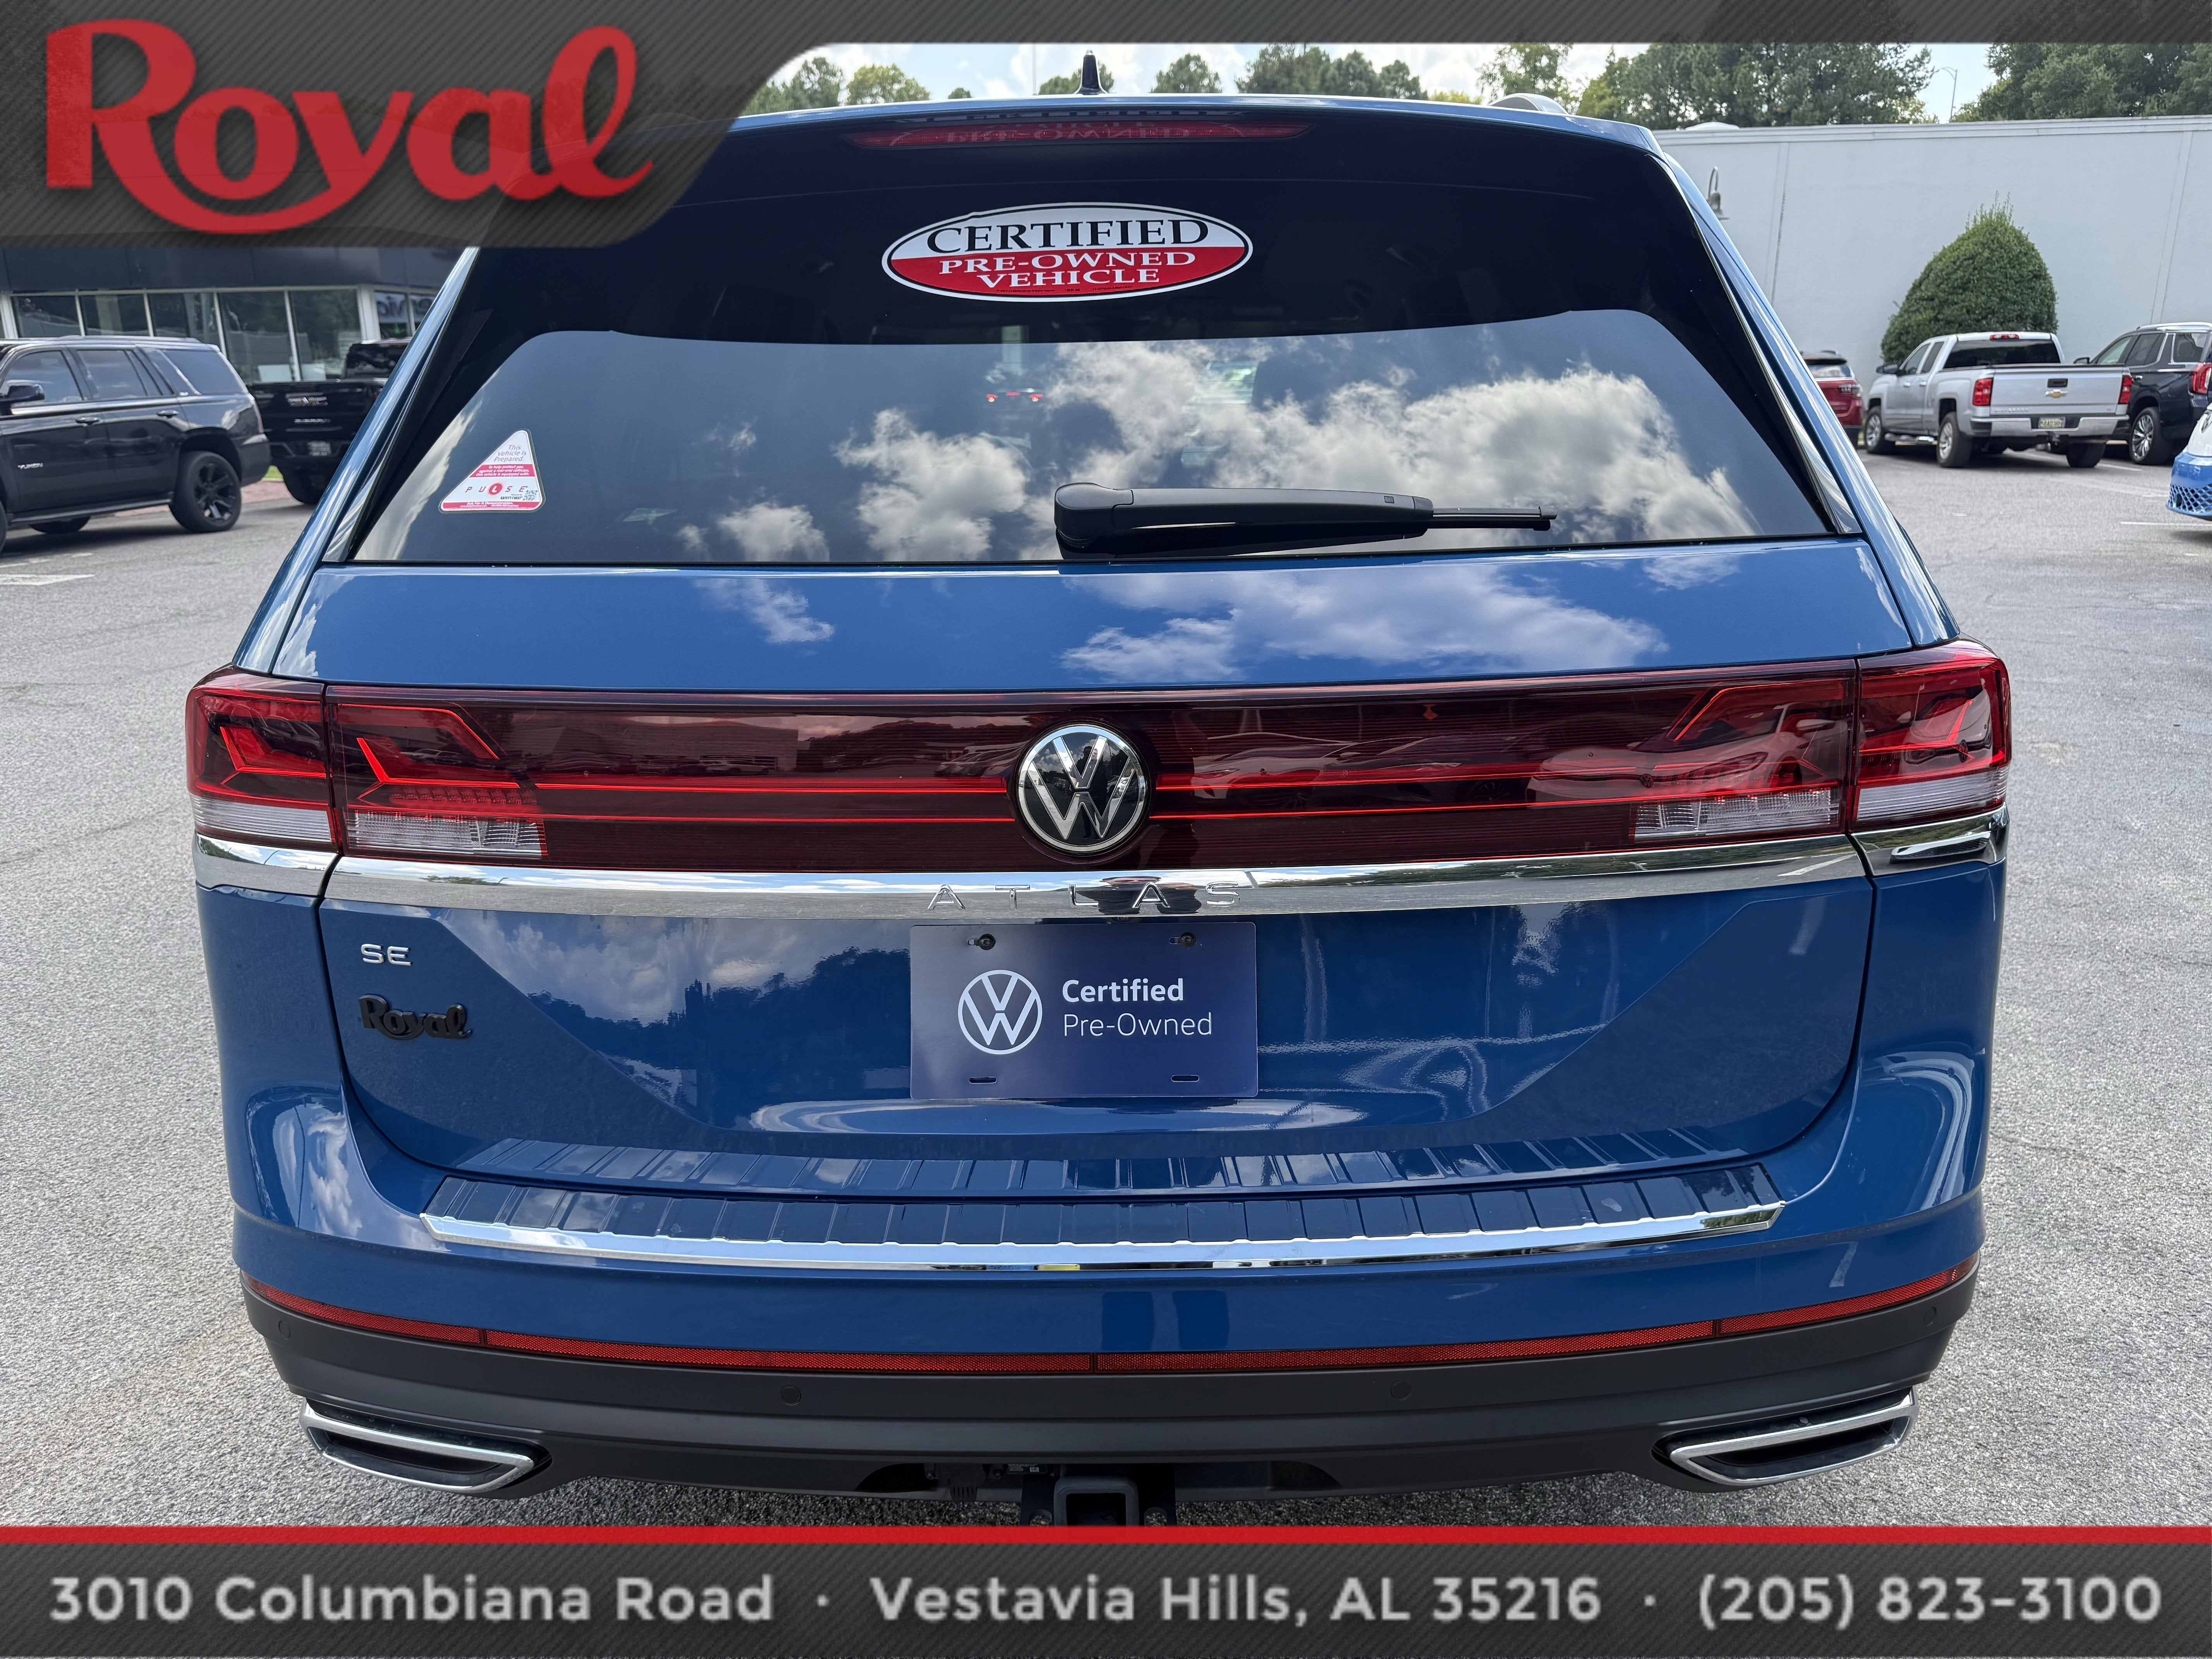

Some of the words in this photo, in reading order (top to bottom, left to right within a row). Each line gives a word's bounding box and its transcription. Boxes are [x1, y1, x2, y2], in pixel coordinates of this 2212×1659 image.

[927, 219, 1208, 254] CERTIFIED
[940, 252, 1195, 275] PRE-OWNED
[977, 269, 1159, 288] VEHICLE
[927, 881, 1240, 910] ATLAS
[361, 944, 412, 966] SE
[1062, 978, 1184, 1002] Certified
[359, 994, 472, 1040] Royal
[1064, 1012, 1212, 1036] Pre-Owned
